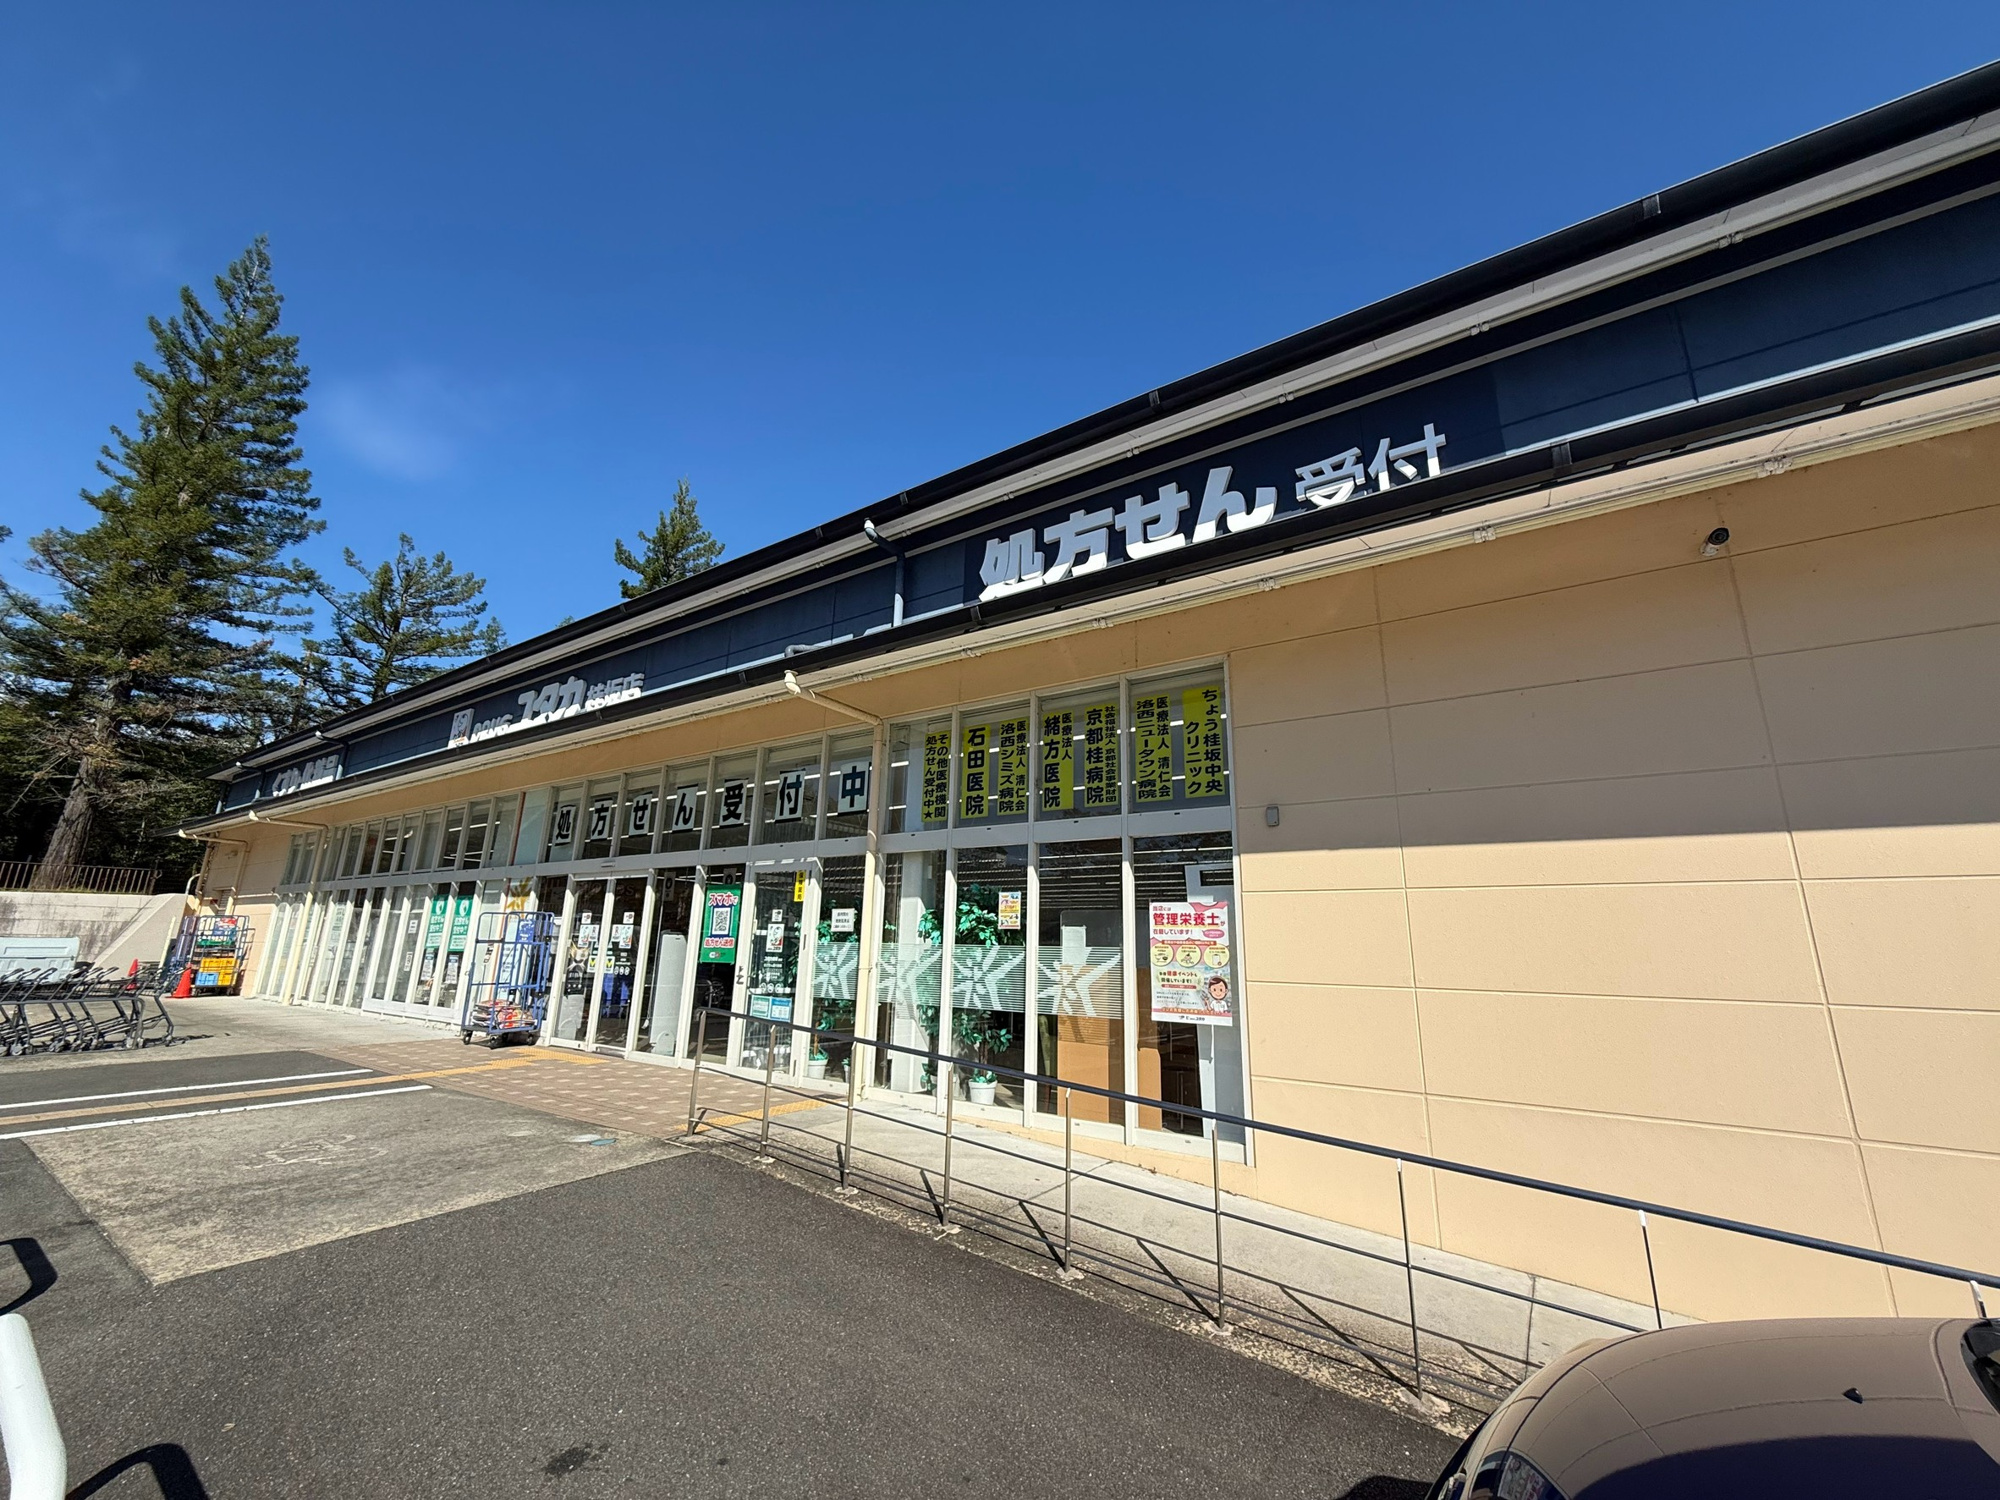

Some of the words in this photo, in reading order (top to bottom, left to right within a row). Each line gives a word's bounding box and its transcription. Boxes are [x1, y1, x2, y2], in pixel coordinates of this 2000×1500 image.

[979, 466, 1277, 602] 処方せん
[1295, 423, 1446, 510] 受付
[1016, 720, 1026, 768] 医療法人
[1044, 715, 1061, 808] 緒方医院
[1061, 712, 1072, 760] 医療法人
[1086, 709, 1104, 804] 京都桂病院
[1105, 706, 1116, 746] 社会福祉法人
[1137, 699, 1157, 799] 洛西ニュータウン病院
[1156, 696, 1169, 750] 医療法人
[1186, 721, 1202, 795] クリニック
[1202, 689, 1223, 793] ちょう桂坂中央
[934, 734, 949, 818] その他医療機関
[965, 727, 986, 816] 石田医院
[999, 723, 1016, 812] 洛西シミズ病院
[1015, 774, 1026, 811] 清仁会
[1158, 757, 1171, 797] 清仁会
[1153, 913, 1225, 926] 管理栄養士が
